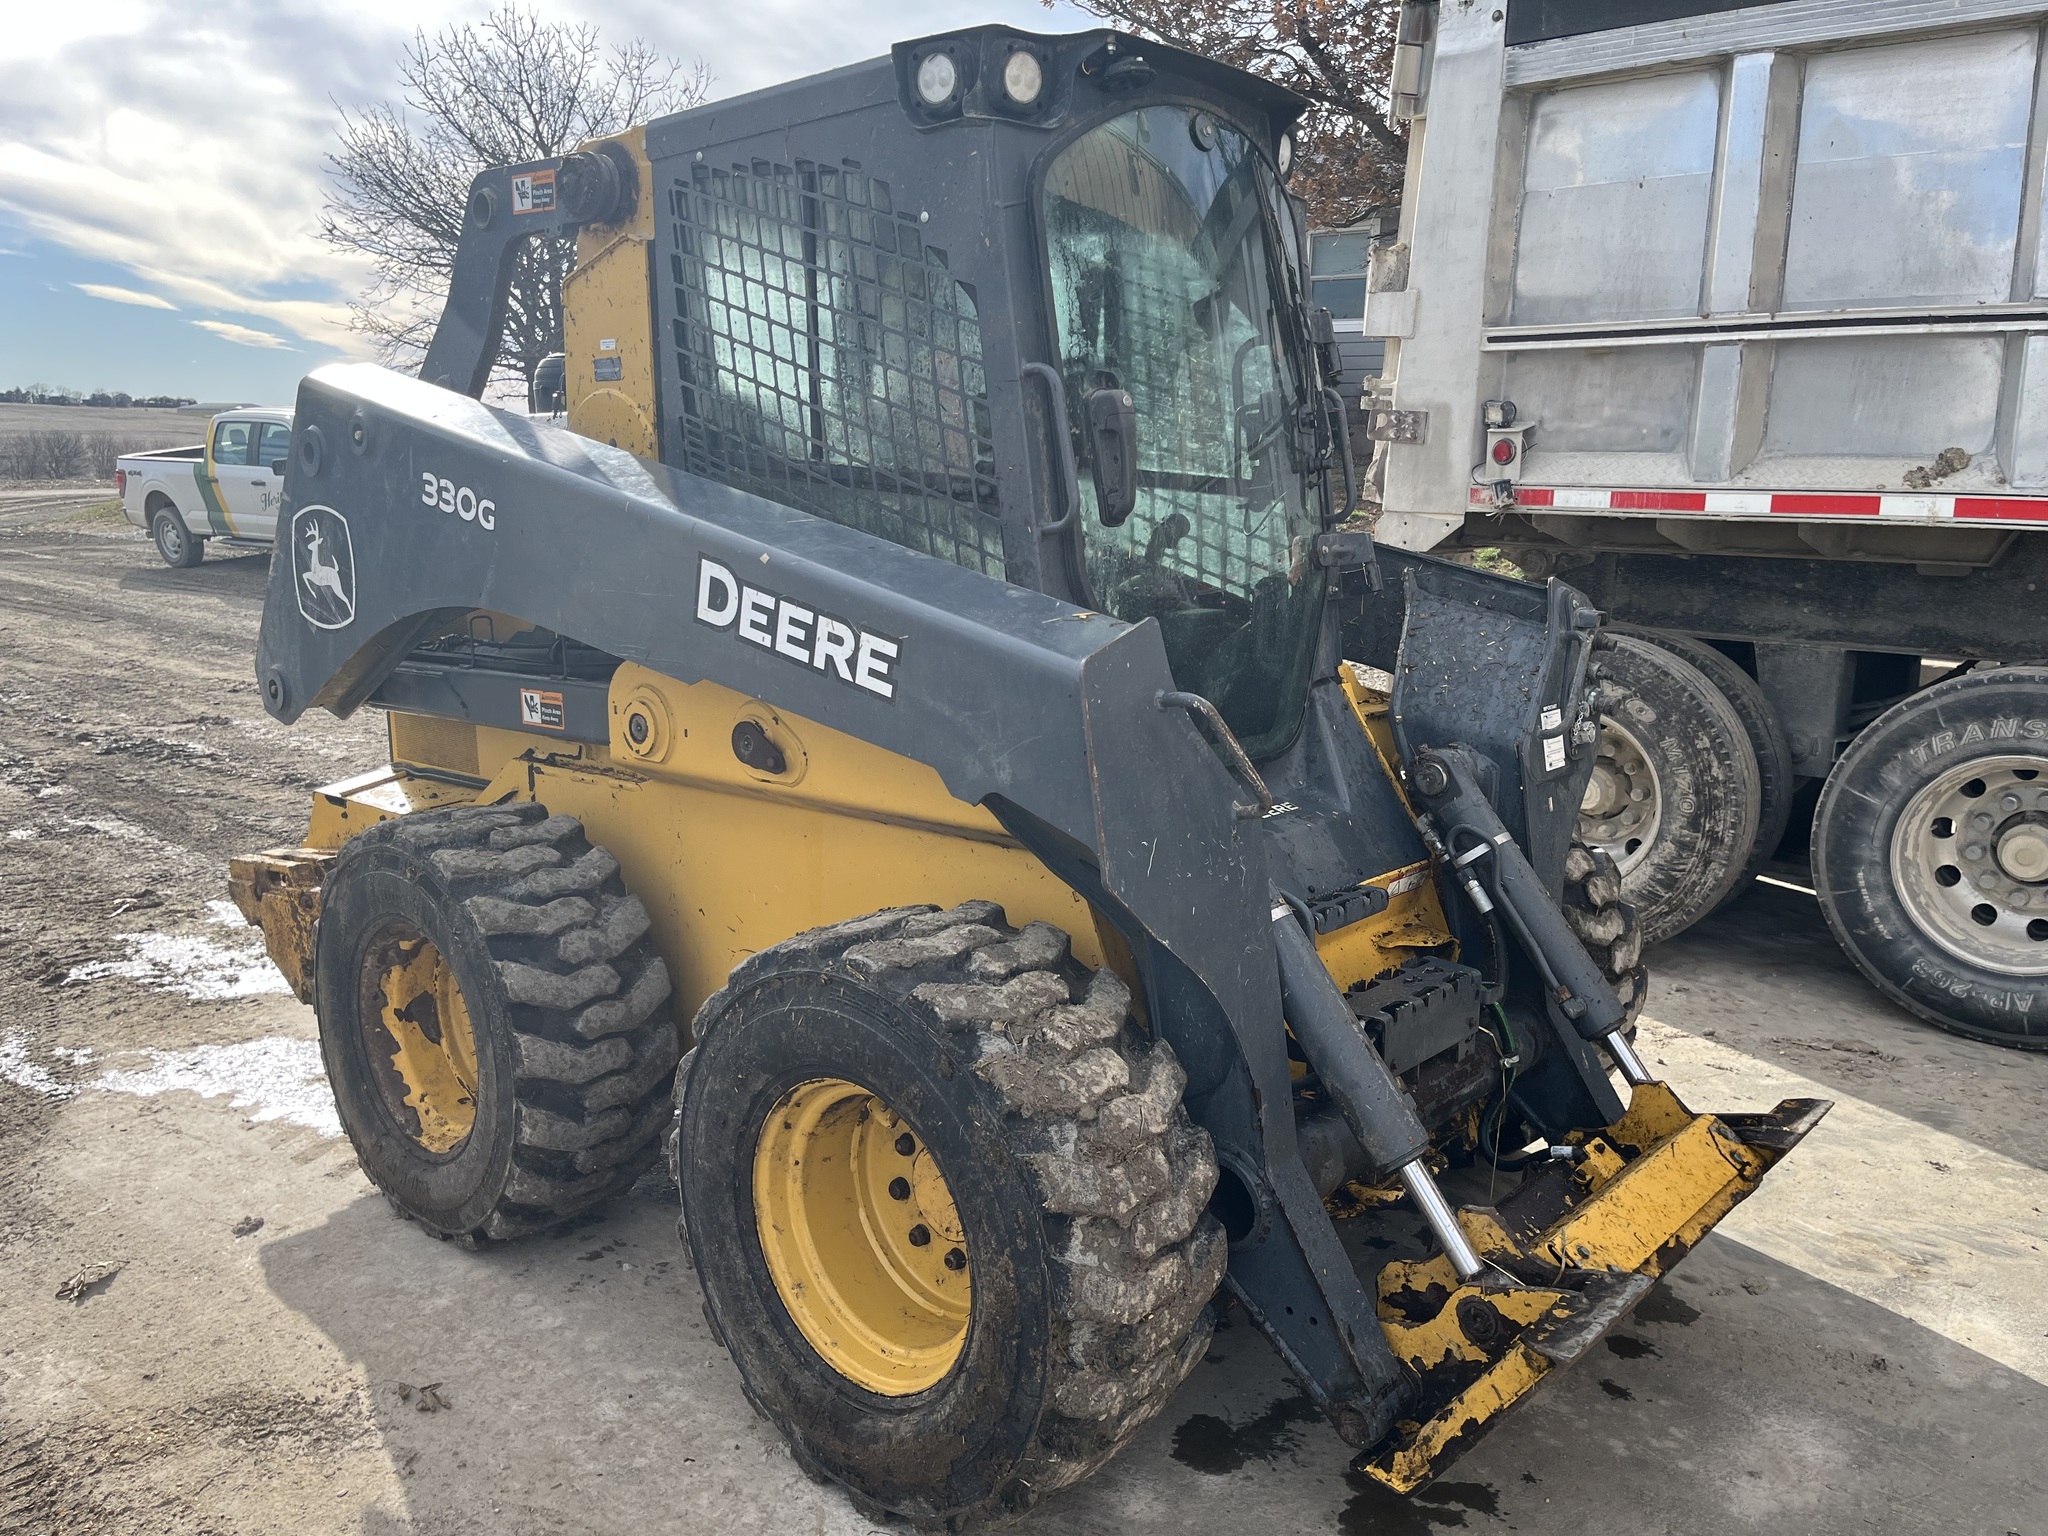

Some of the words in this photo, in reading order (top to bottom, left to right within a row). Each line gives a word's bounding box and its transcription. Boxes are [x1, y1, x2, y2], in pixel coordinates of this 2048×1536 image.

[421, 471, 496, 531] 330G
[697, 558, 898, 698] DEERE
[1262, 801, 1299, 819] ERE
